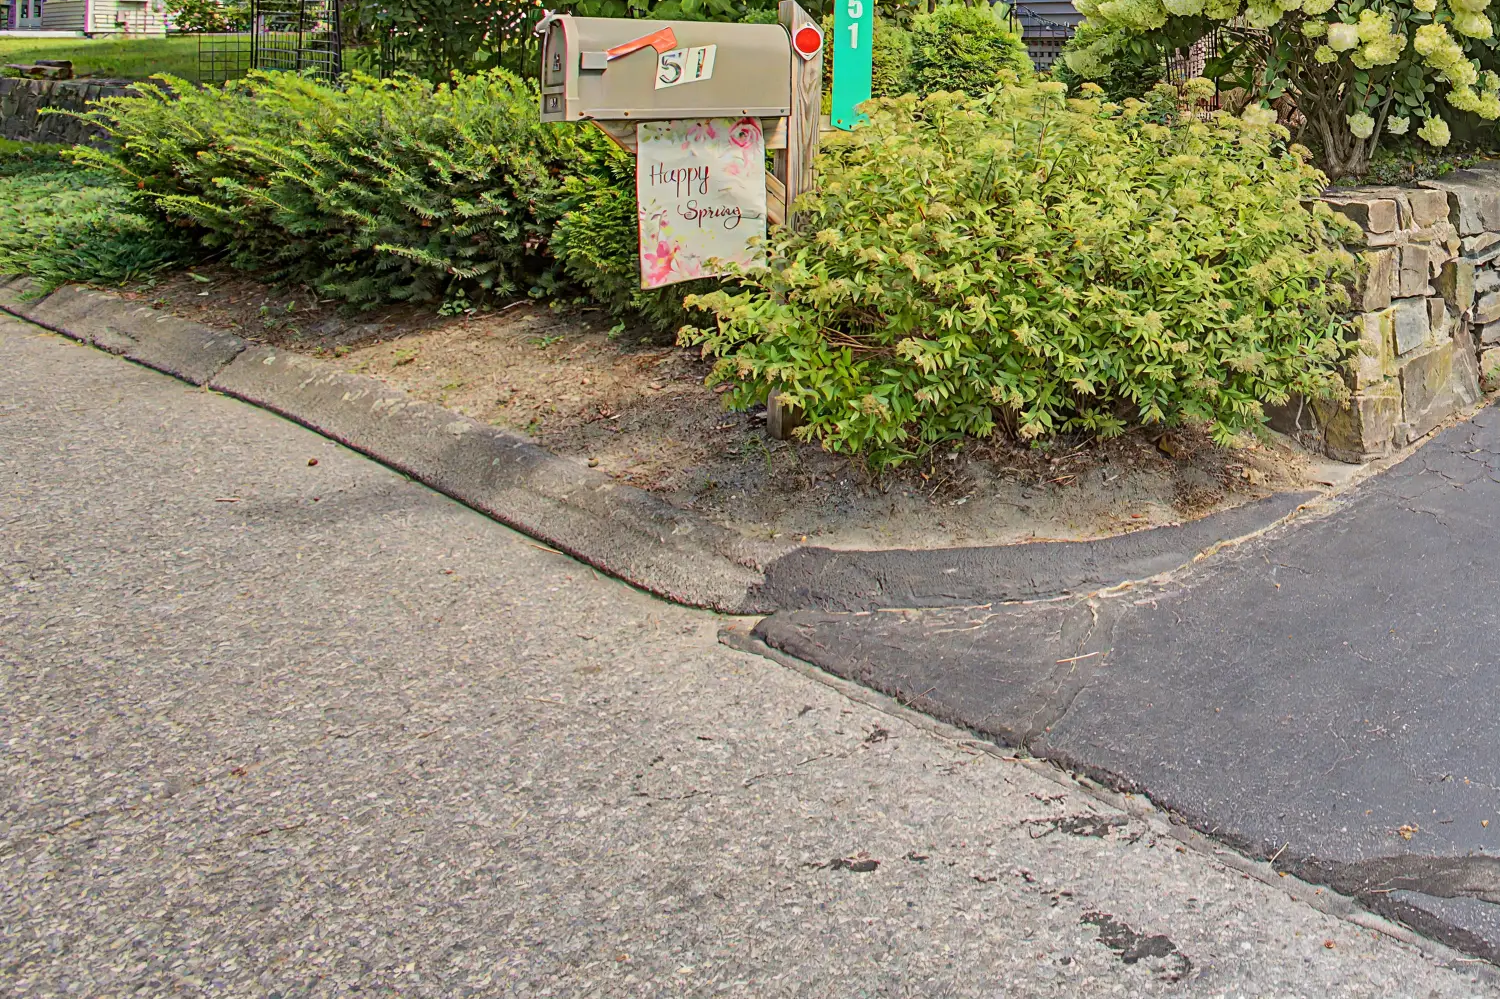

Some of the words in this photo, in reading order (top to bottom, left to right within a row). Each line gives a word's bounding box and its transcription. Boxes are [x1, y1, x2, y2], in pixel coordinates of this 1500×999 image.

[659, 47, 707, 84] 51
[649, 162, 709, 197] Happy
[677, 199, 761, 229] Spring
